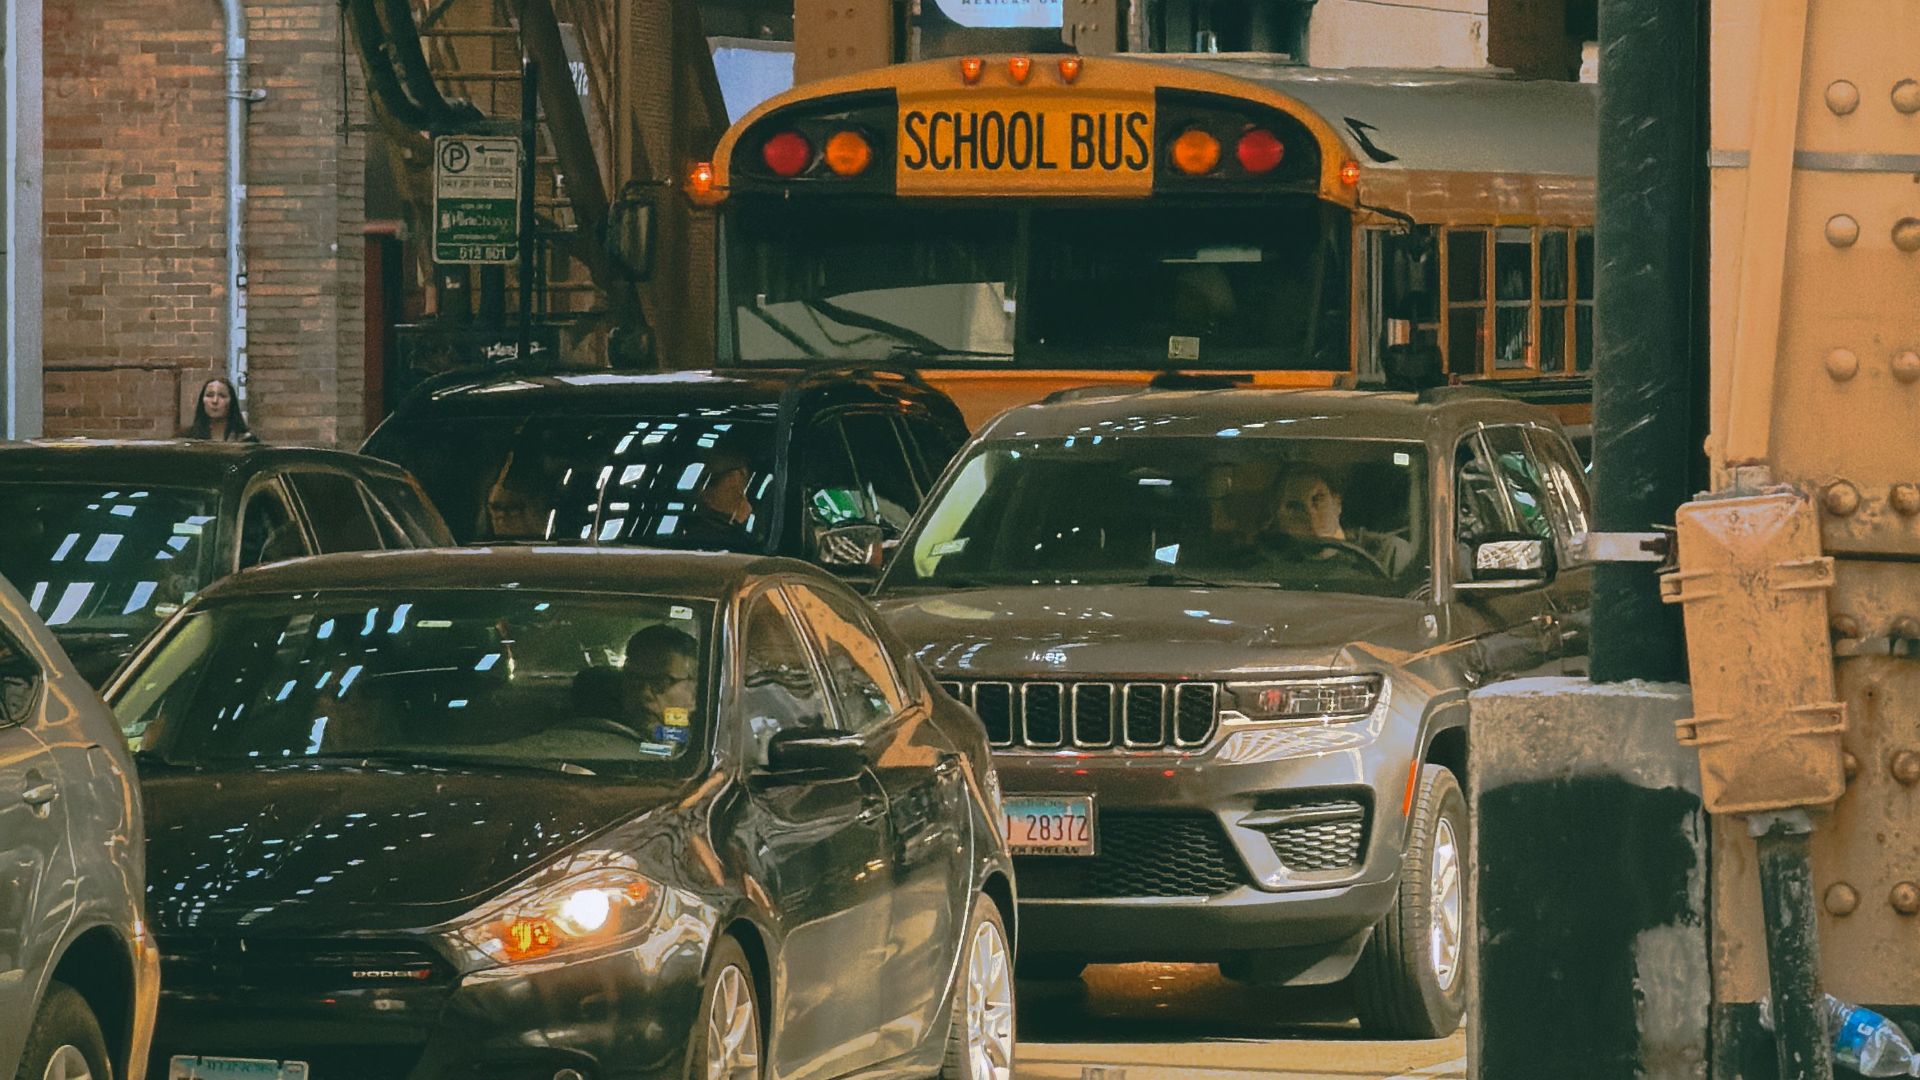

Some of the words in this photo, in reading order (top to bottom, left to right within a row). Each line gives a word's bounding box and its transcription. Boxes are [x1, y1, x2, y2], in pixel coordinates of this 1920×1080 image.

[904, 111, 1057, 170] SCHOOL
[1070, 112, 1149, 171] BUS
[1026, 814, 1088, 842] 28372
[352, 970, 419, 978] DODGE
